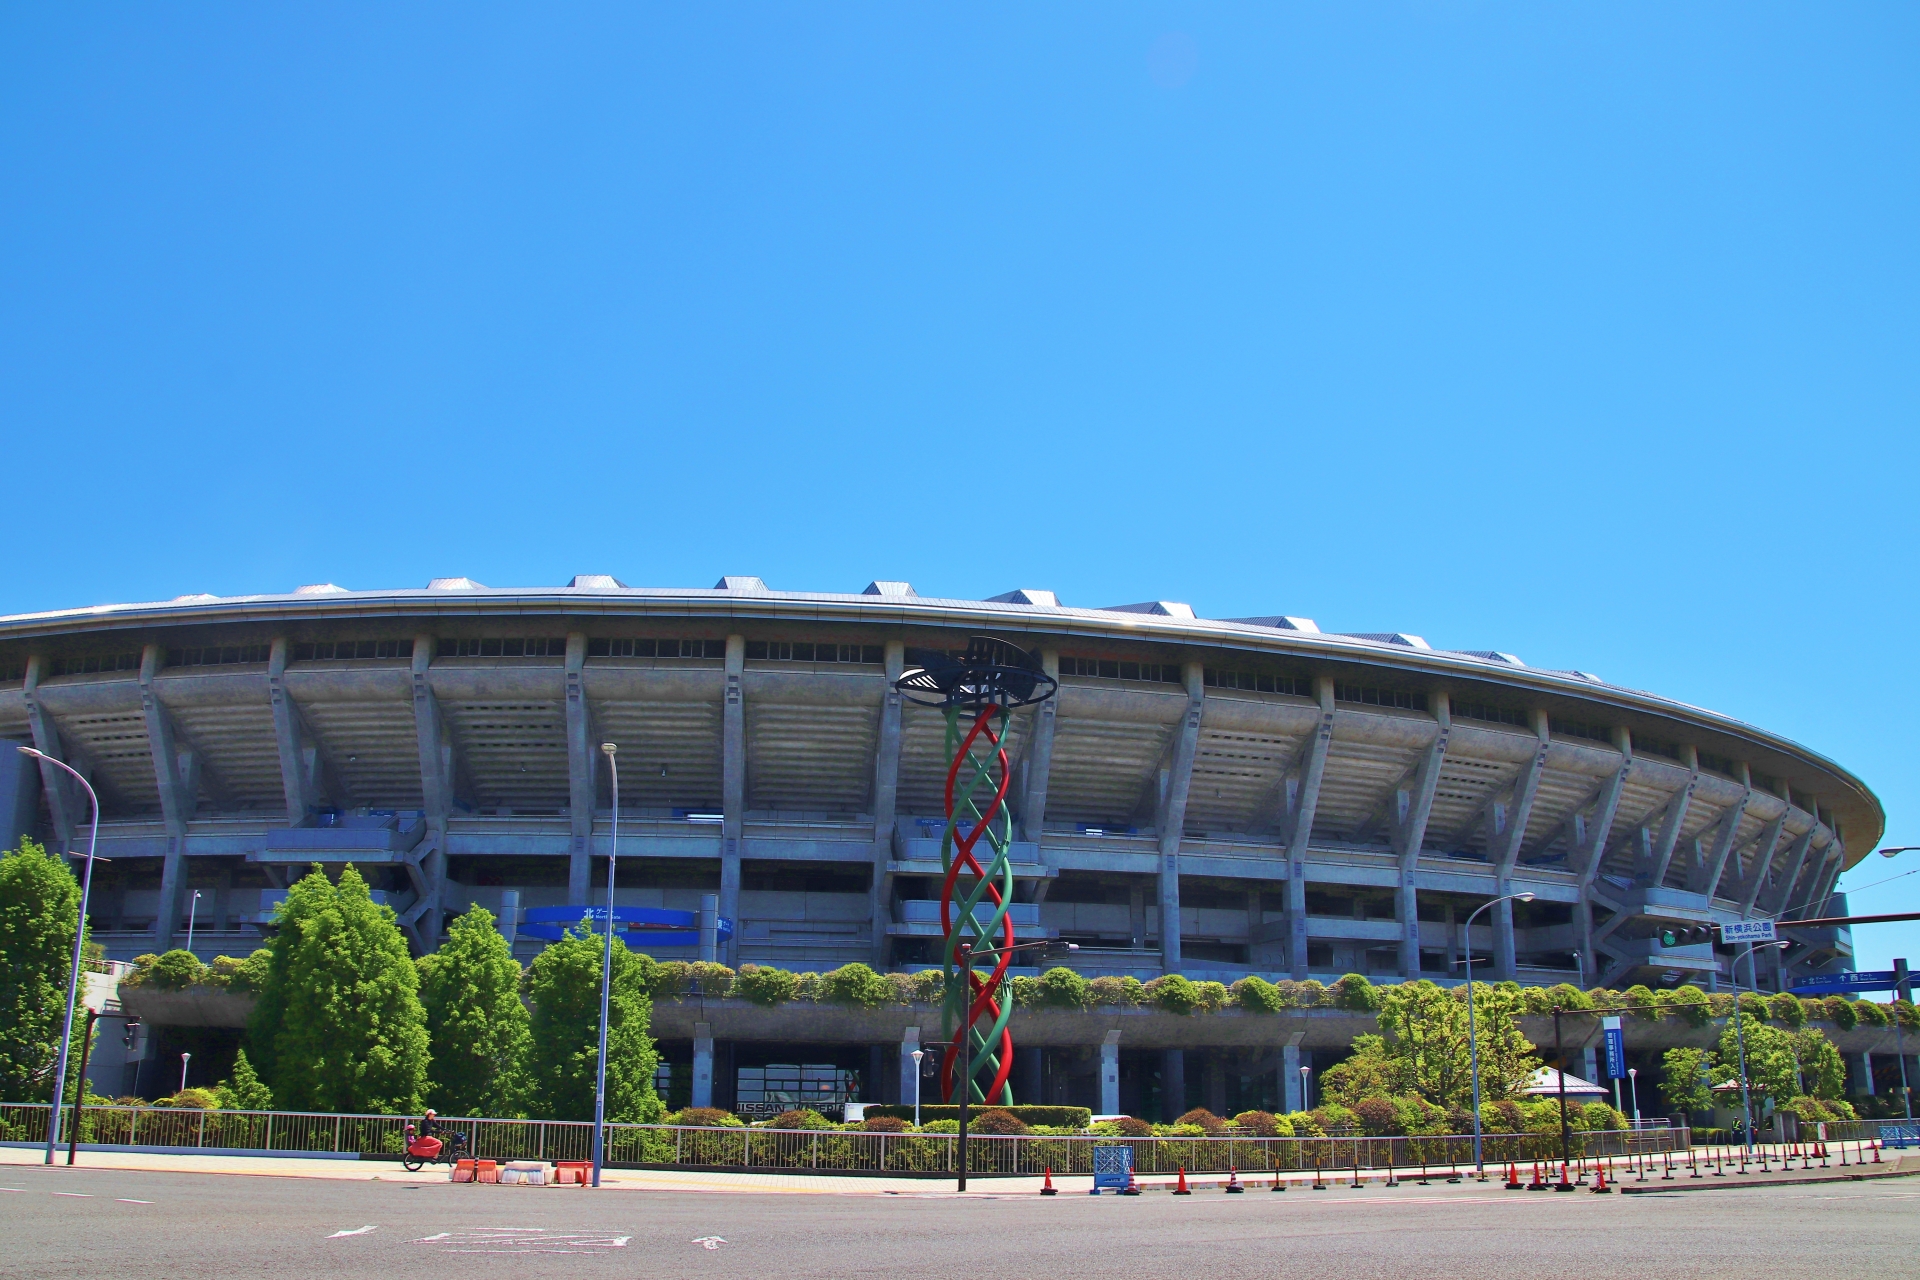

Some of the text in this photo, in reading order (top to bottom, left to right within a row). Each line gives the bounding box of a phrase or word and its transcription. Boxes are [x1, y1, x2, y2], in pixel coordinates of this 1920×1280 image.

[1724, 922, 1772, 934] 新横浜公園
